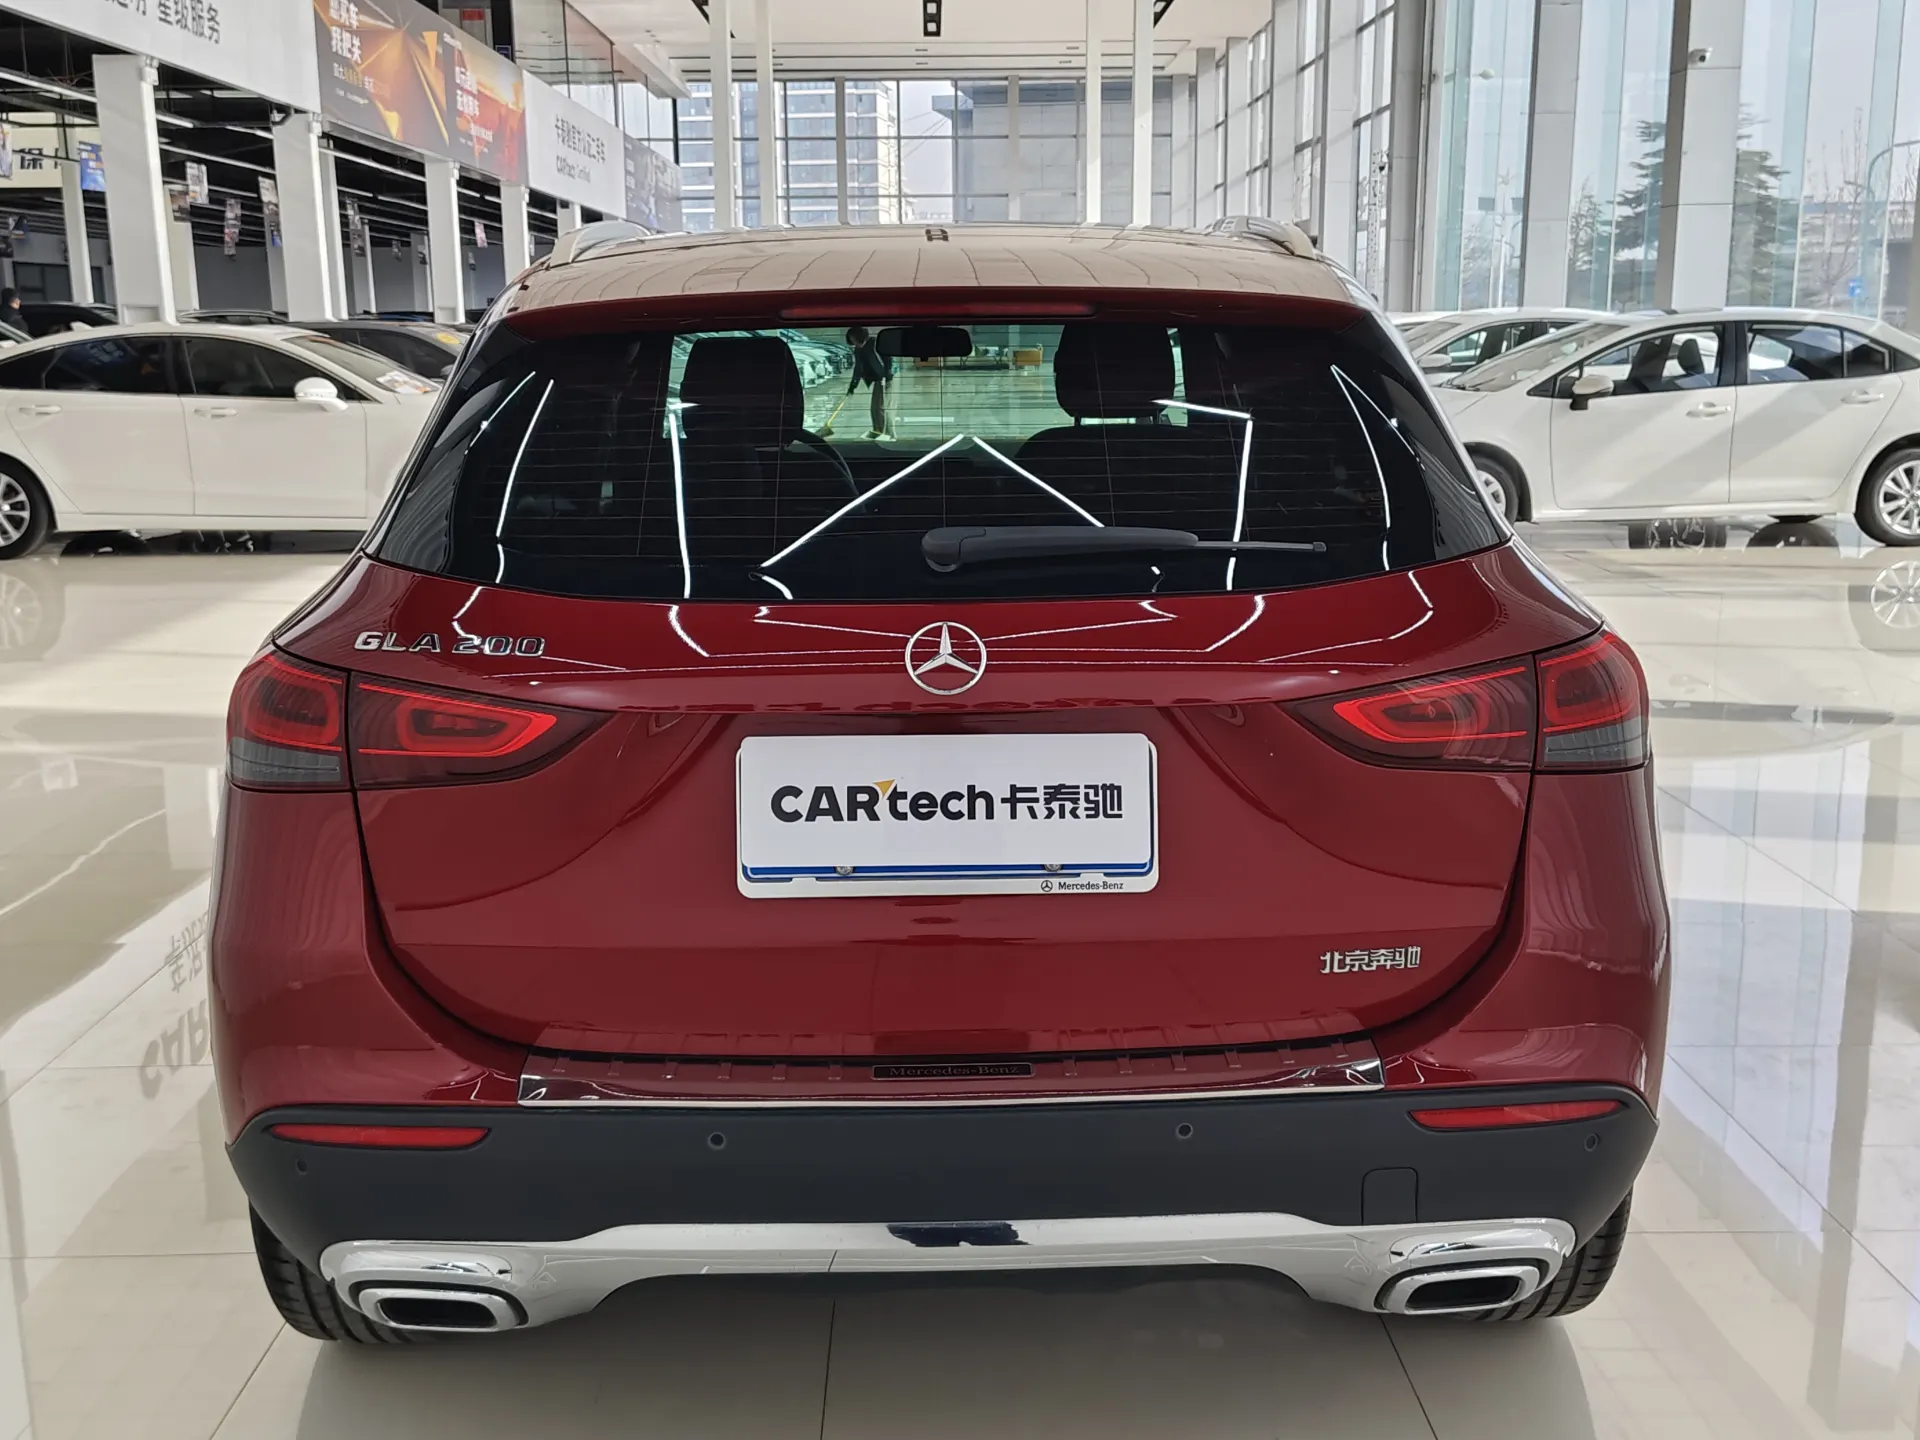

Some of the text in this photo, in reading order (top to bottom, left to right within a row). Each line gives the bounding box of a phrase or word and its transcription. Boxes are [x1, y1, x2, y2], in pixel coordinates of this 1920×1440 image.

[354, 631, 546, 657] GLA 200
[770, 780, 1123, 822] CARtech 卡泰驰
[1058, 881, 1124, 891] Mercedes-Benz
[1320, 945, 1421, 974] 北京奔驰
[890, 1065, 1019, 1077] Mercedes-Benz
